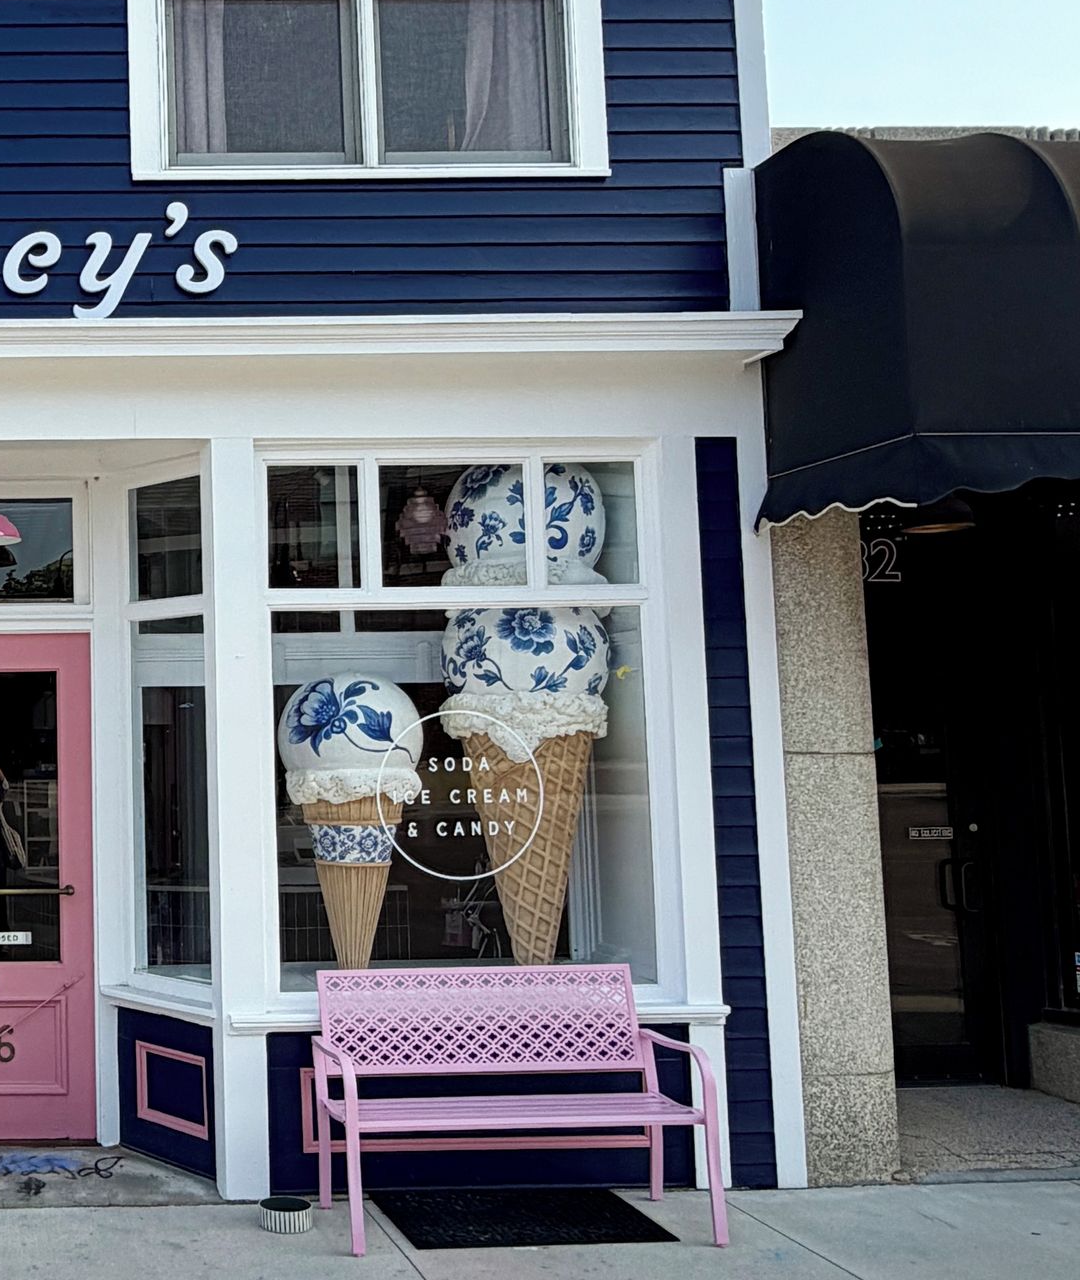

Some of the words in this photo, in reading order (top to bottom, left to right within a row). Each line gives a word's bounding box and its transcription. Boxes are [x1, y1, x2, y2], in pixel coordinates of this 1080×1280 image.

[428, 756, 490, 773] SODA
[393, 789, 431, 806] ICE
[449, 788, 528, 805] CREAM
[407, 821, 418, 838] &
[436, 821, 516, 837] CANDY
